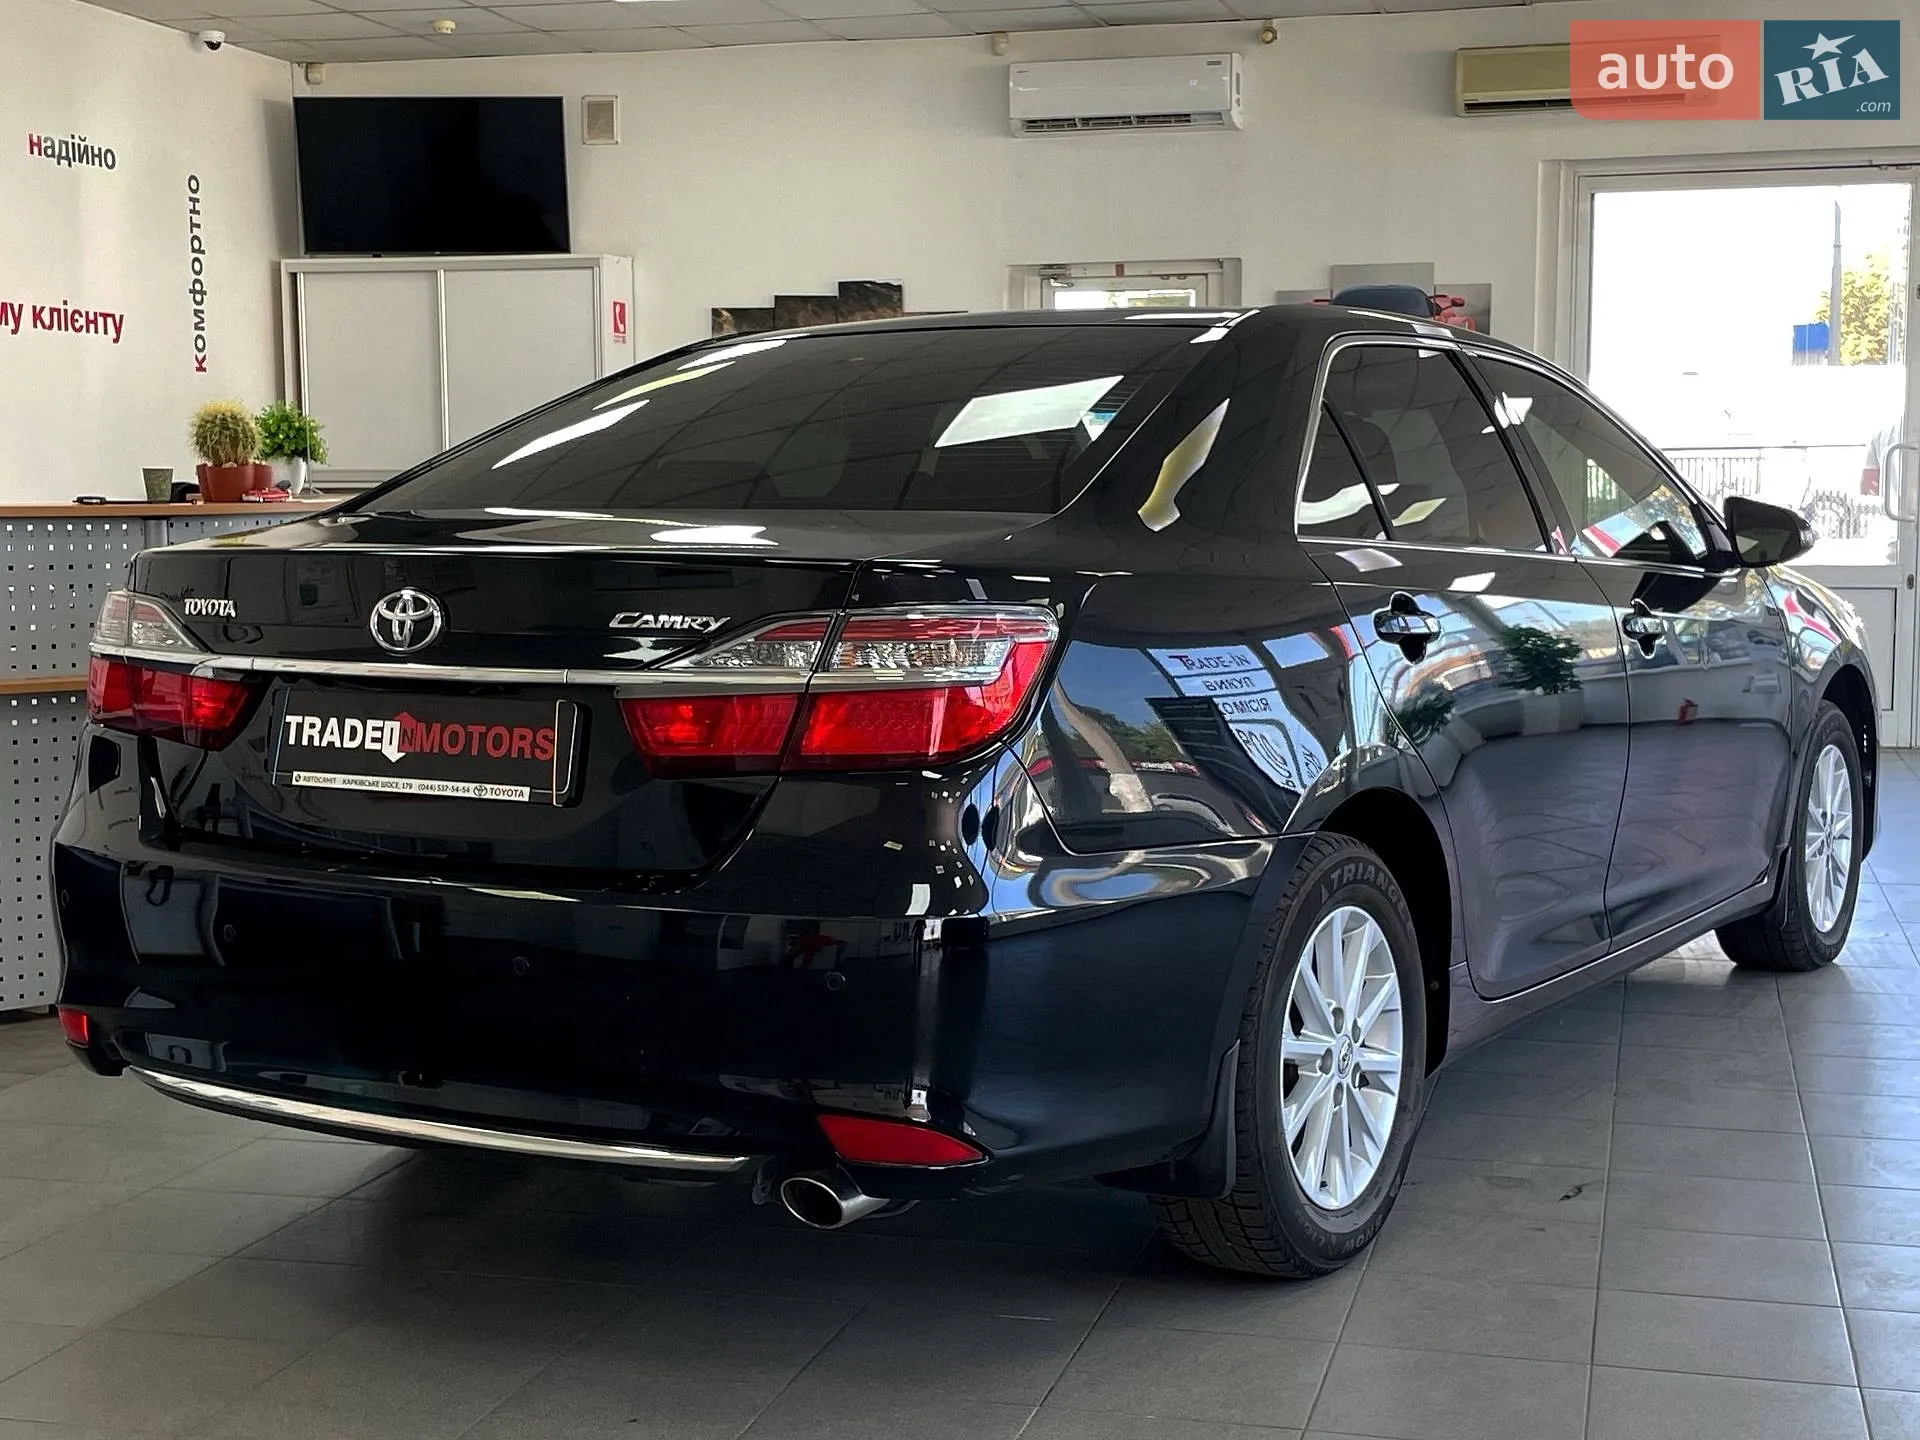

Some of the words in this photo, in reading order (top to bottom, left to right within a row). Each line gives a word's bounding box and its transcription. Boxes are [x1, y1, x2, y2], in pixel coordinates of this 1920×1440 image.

[28, 133, 117, 170] надійно
[187, 174, 208, 373] комфортно
[31, 299, 125, 344] клієнту
[184, 598, 236, 618] TOYOTA
[608, 611, 732, 633] CAMRY
[285, 714, 384, 751] TRADE
[417, 722, 555, 761] MOTORS
[489, 787, 525, 798] TOYOTA
